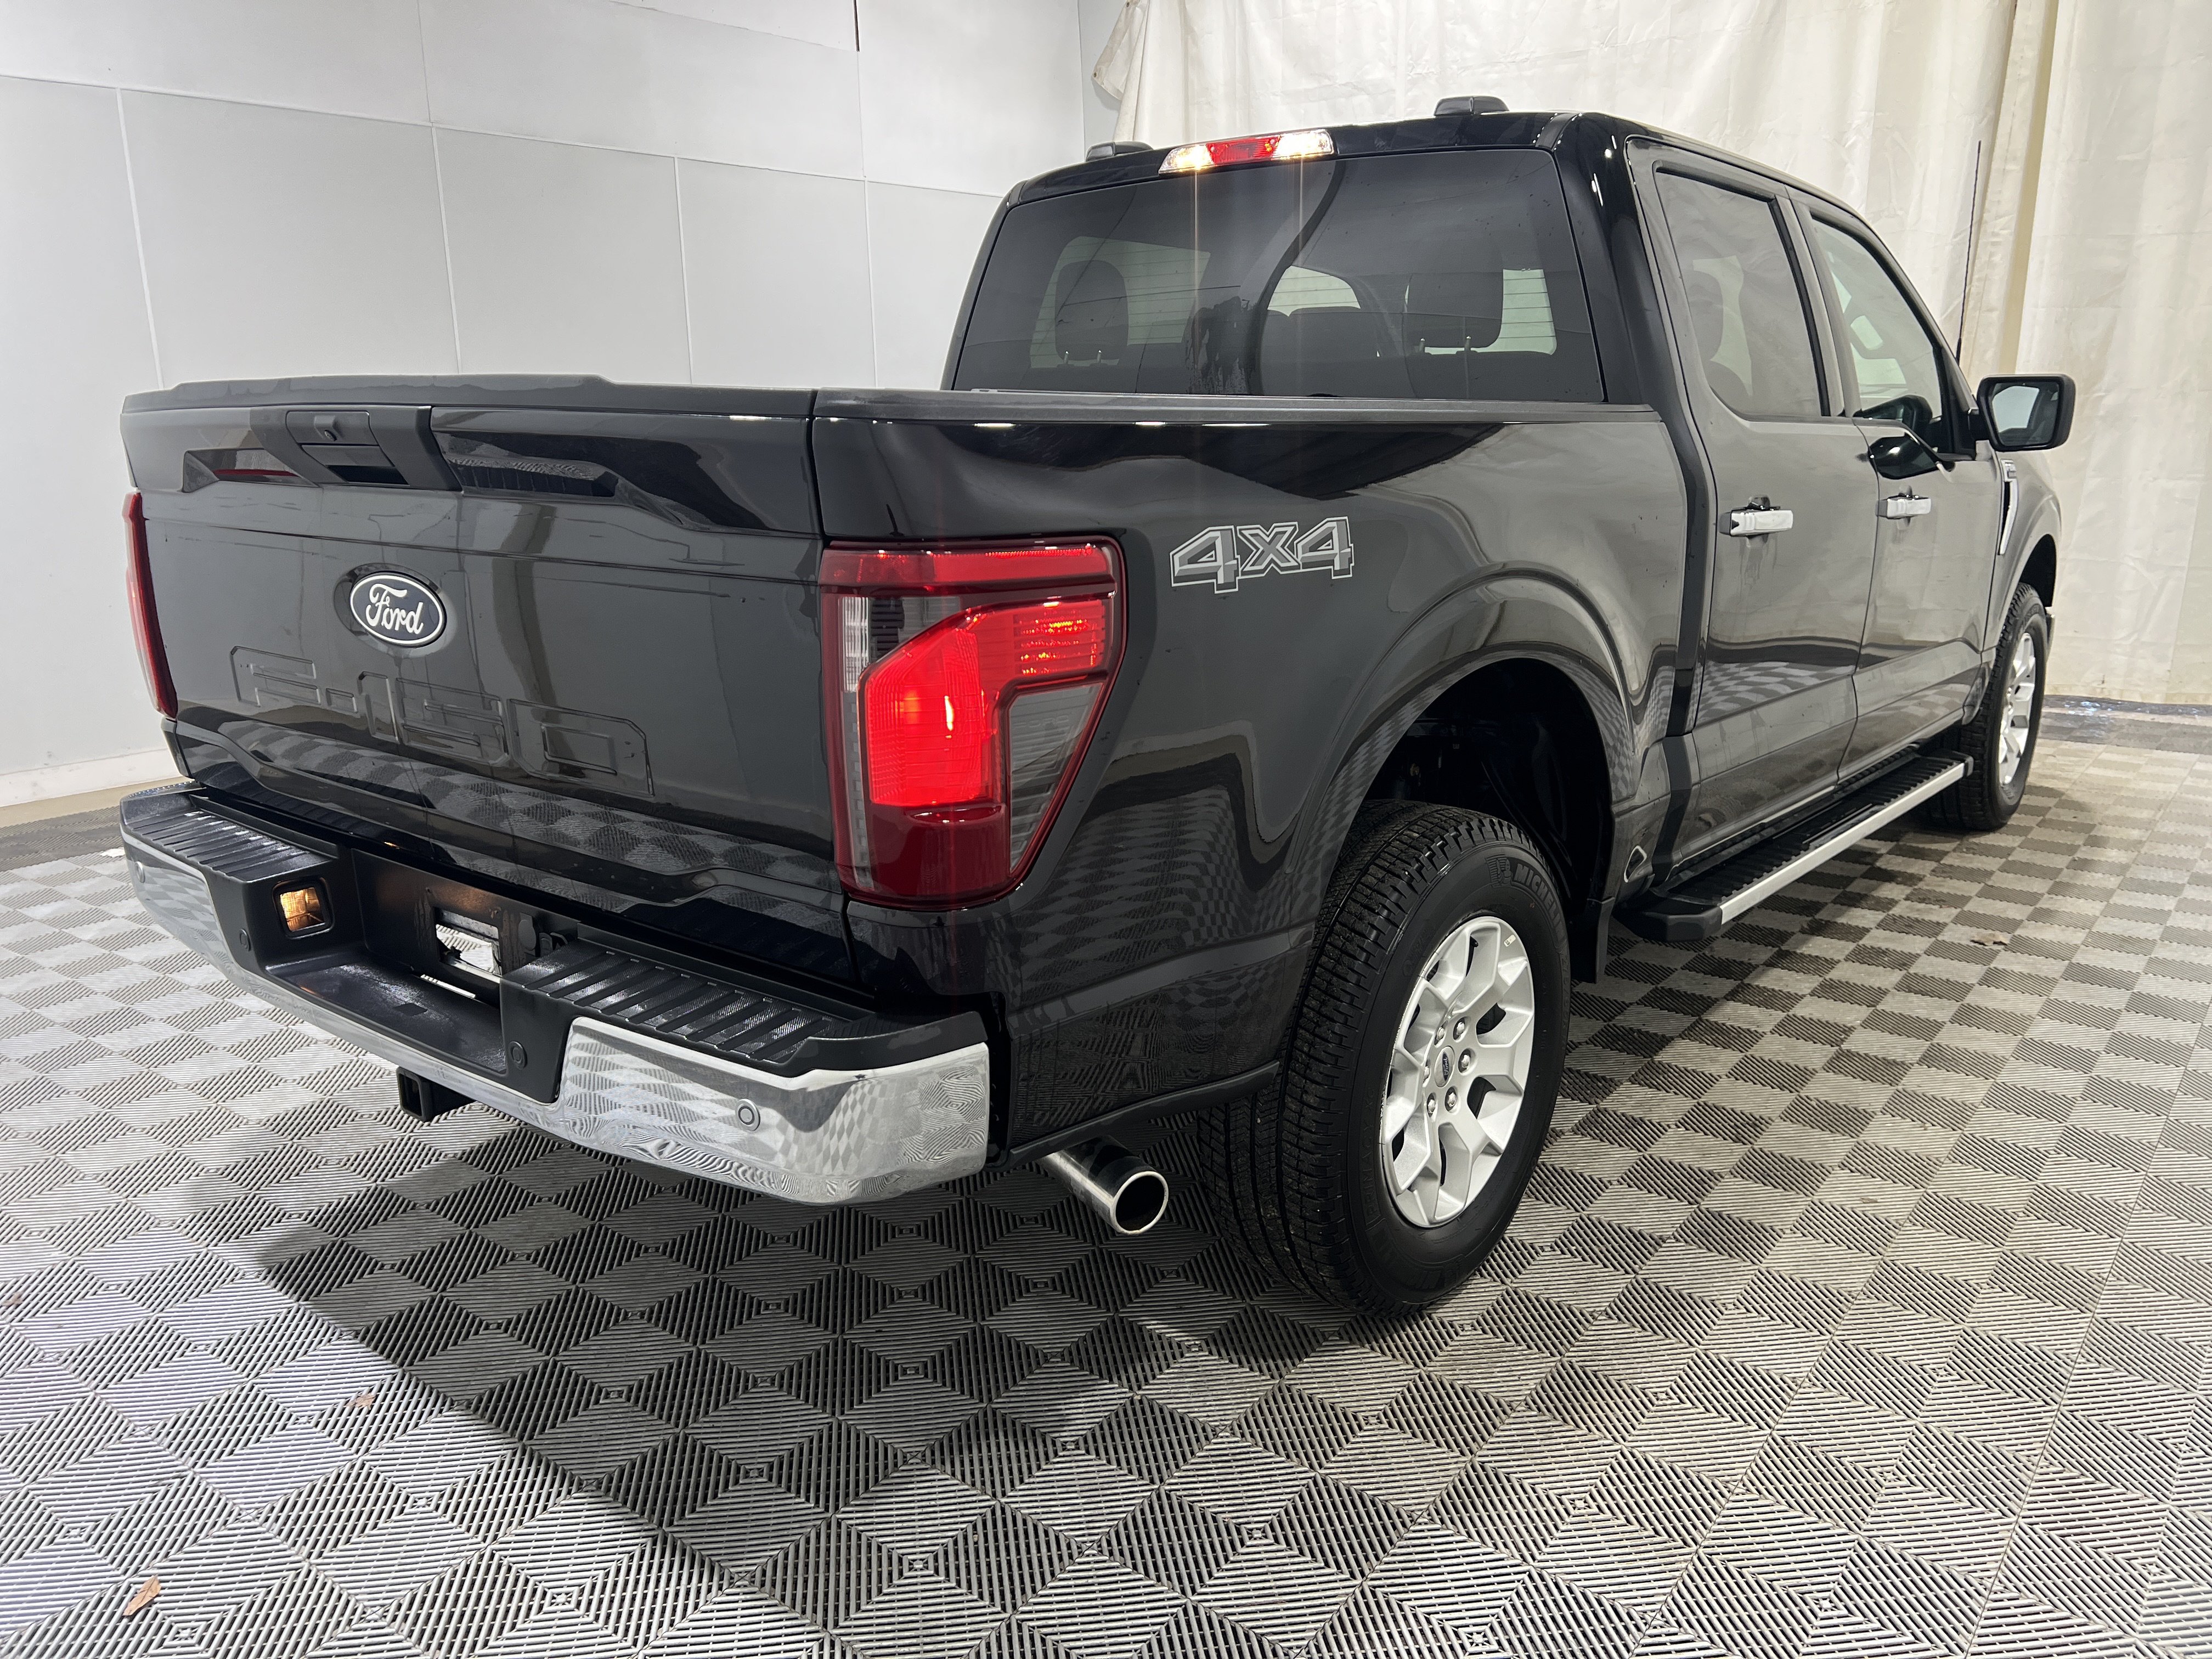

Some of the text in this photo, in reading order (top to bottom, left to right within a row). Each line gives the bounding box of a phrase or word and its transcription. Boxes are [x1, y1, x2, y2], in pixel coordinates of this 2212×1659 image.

[365, 583, 424, 634] Ford
[230, 645, 656, 797] F-150
[1514, 863, 1565, 941] MICHELIN
[1362, 1122, 1379, 1217] PRIMACY
